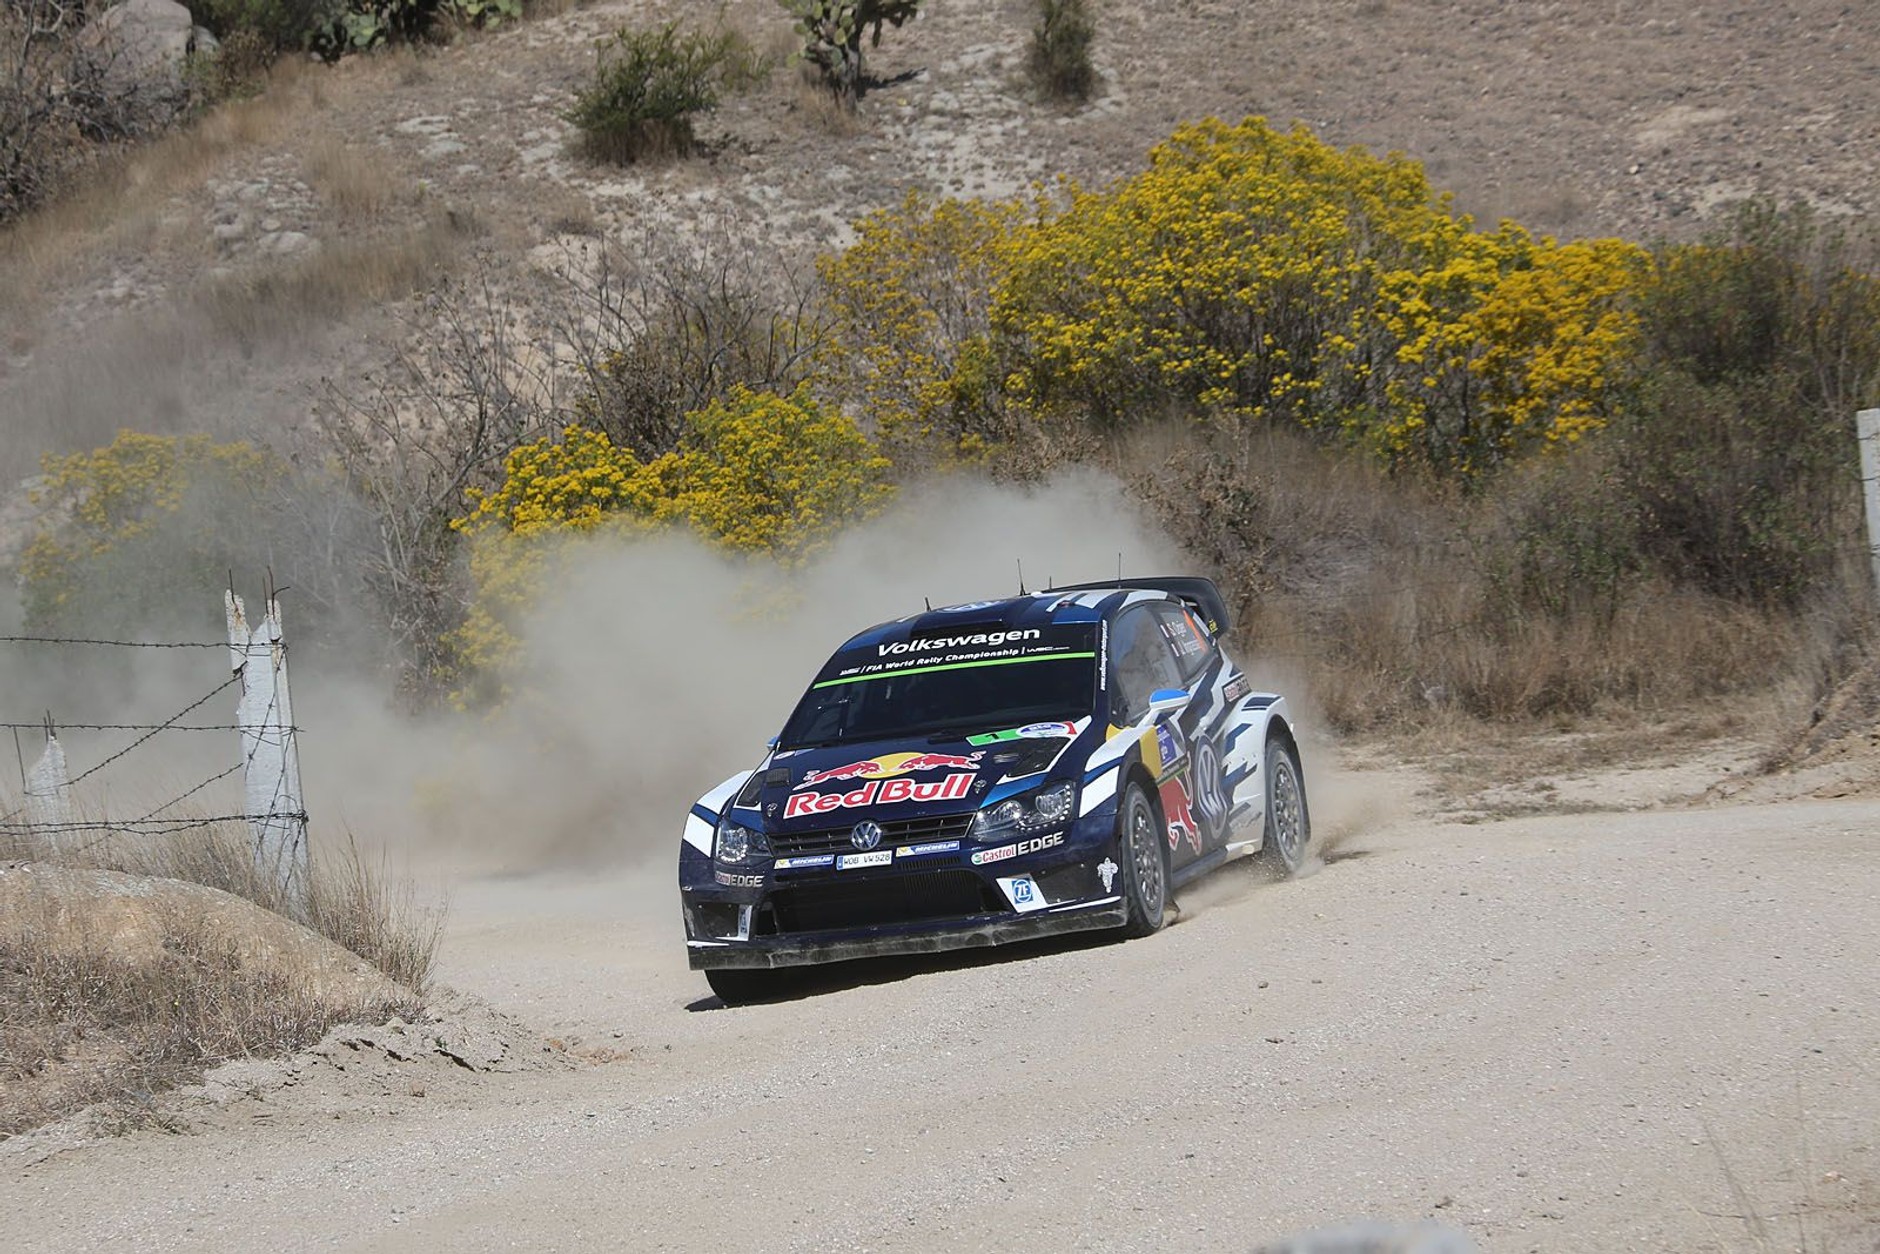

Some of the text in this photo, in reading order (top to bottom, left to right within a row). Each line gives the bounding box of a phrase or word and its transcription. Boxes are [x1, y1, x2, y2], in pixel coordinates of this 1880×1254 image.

[878, 628, 1041, 657] Volkswagen
[866, 664, 883, 673] FIA
[886, 659, 915, 670] World
[917, 655, 943, 666] Rally
[945, 647, 1019, 662] Championship
[783, 773, 978, 819] Red Bull
[915, 843, 957, 852] MICHELIN
[983, 831, 1064, 862] Castrol EDGE
[791, 856, 832, 865] MICHELIN
[731, 874, 765, 888] EDGE
[1017, 882, 1030, 897] ZF
